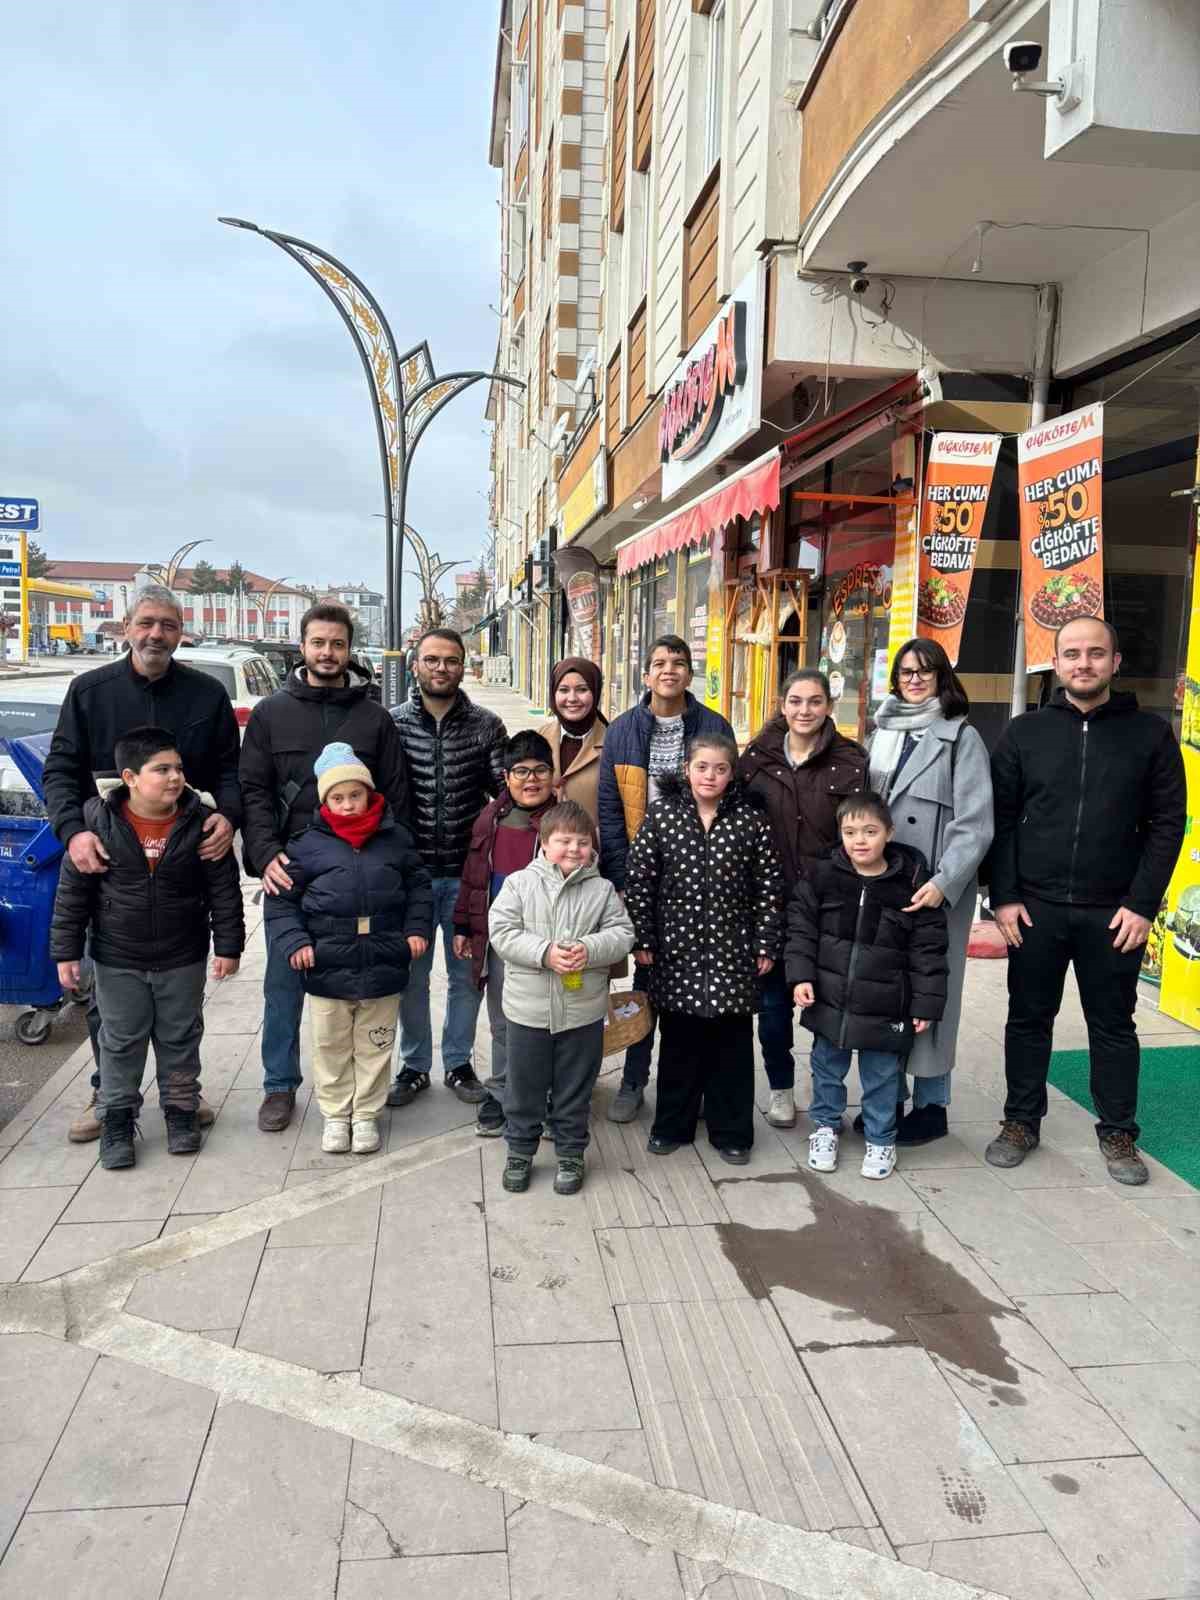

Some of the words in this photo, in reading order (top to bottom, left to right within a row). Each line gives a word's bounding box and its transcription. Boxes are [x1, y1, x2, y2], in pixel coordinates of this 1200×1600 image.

[928, 486, 951, 500] HER
[953, 486, 989, 500] CUMA
[1024, 480, 1055, 502] HER
[1057, 458, 1101, 489] CUMA
[1039, 484, 1089, 529] %50
[922, 534, 977, 553] ÇİĞKÖFTE
[1031, 516, 1100, 556] ÇİĞKÖFTE
[1042, 536, 1099, 568] BEDAVA
[931, 554, 973, 569] BEDAVA
